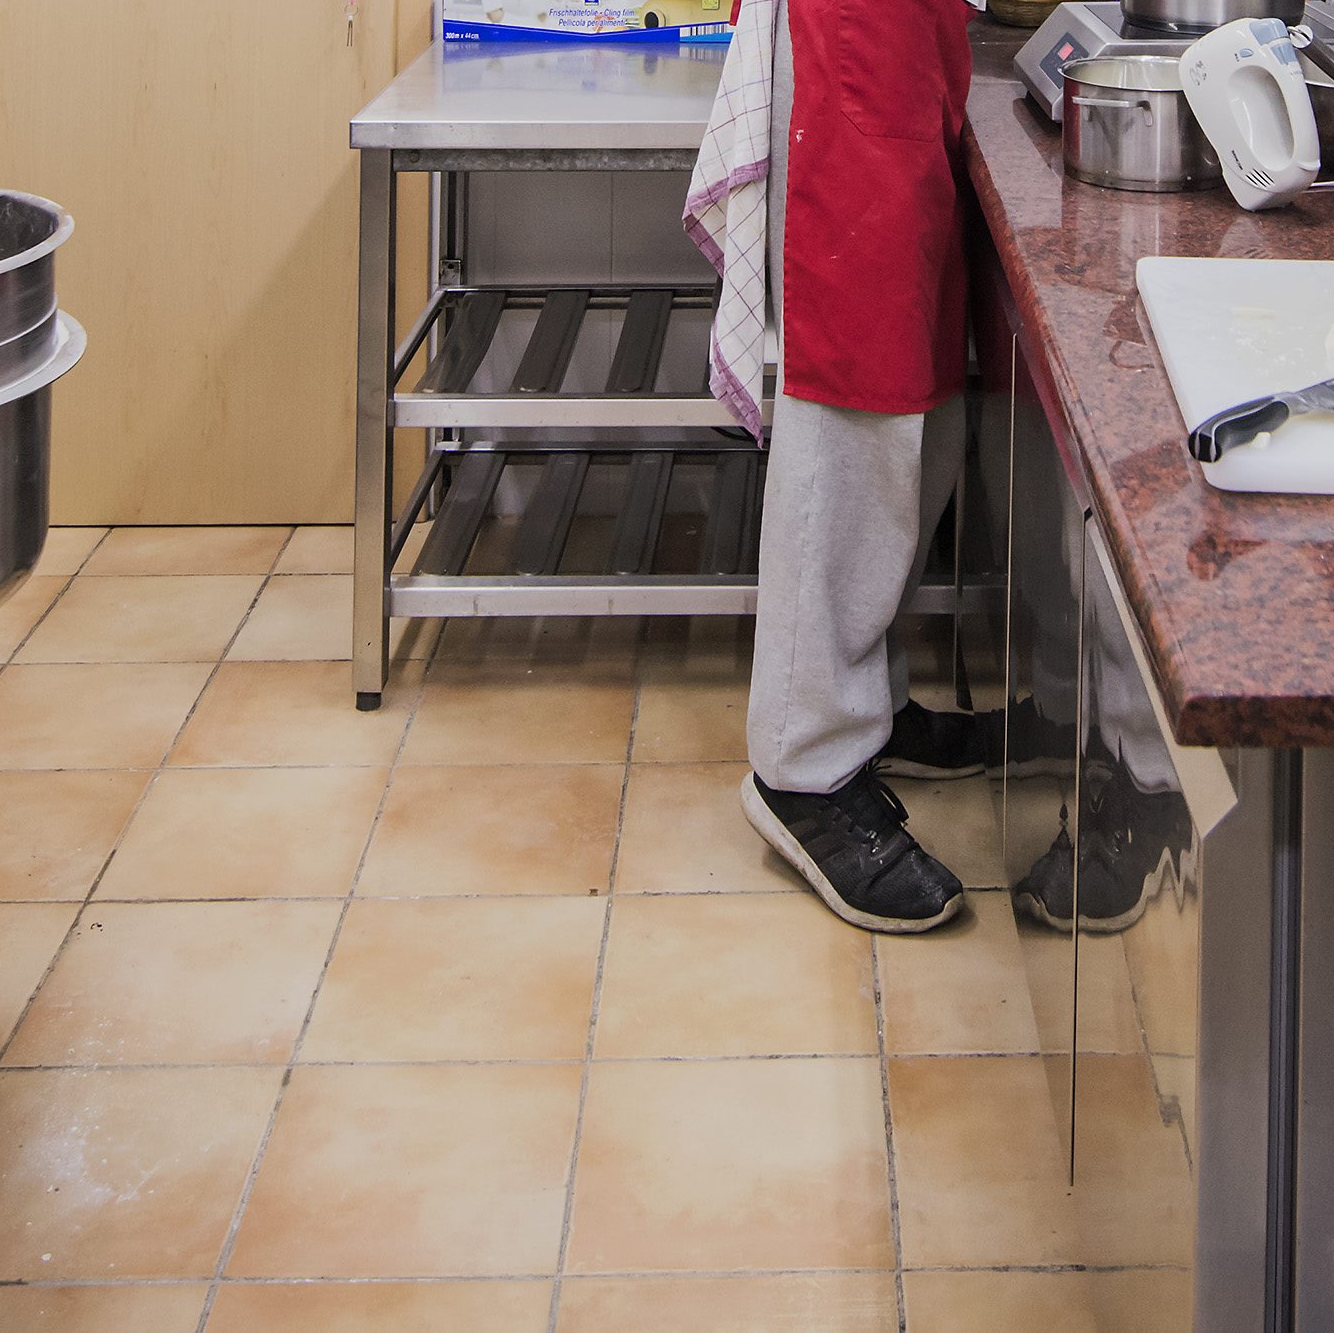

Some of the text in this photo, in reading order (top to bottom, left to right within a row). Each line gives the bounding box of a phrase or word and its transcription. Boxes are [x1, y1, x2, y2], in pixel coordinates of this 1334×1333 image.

[604, 8, 621, 18] Cling
[622, 8, 635, 16] film
[559, 18, 586, 27] Pellicola
